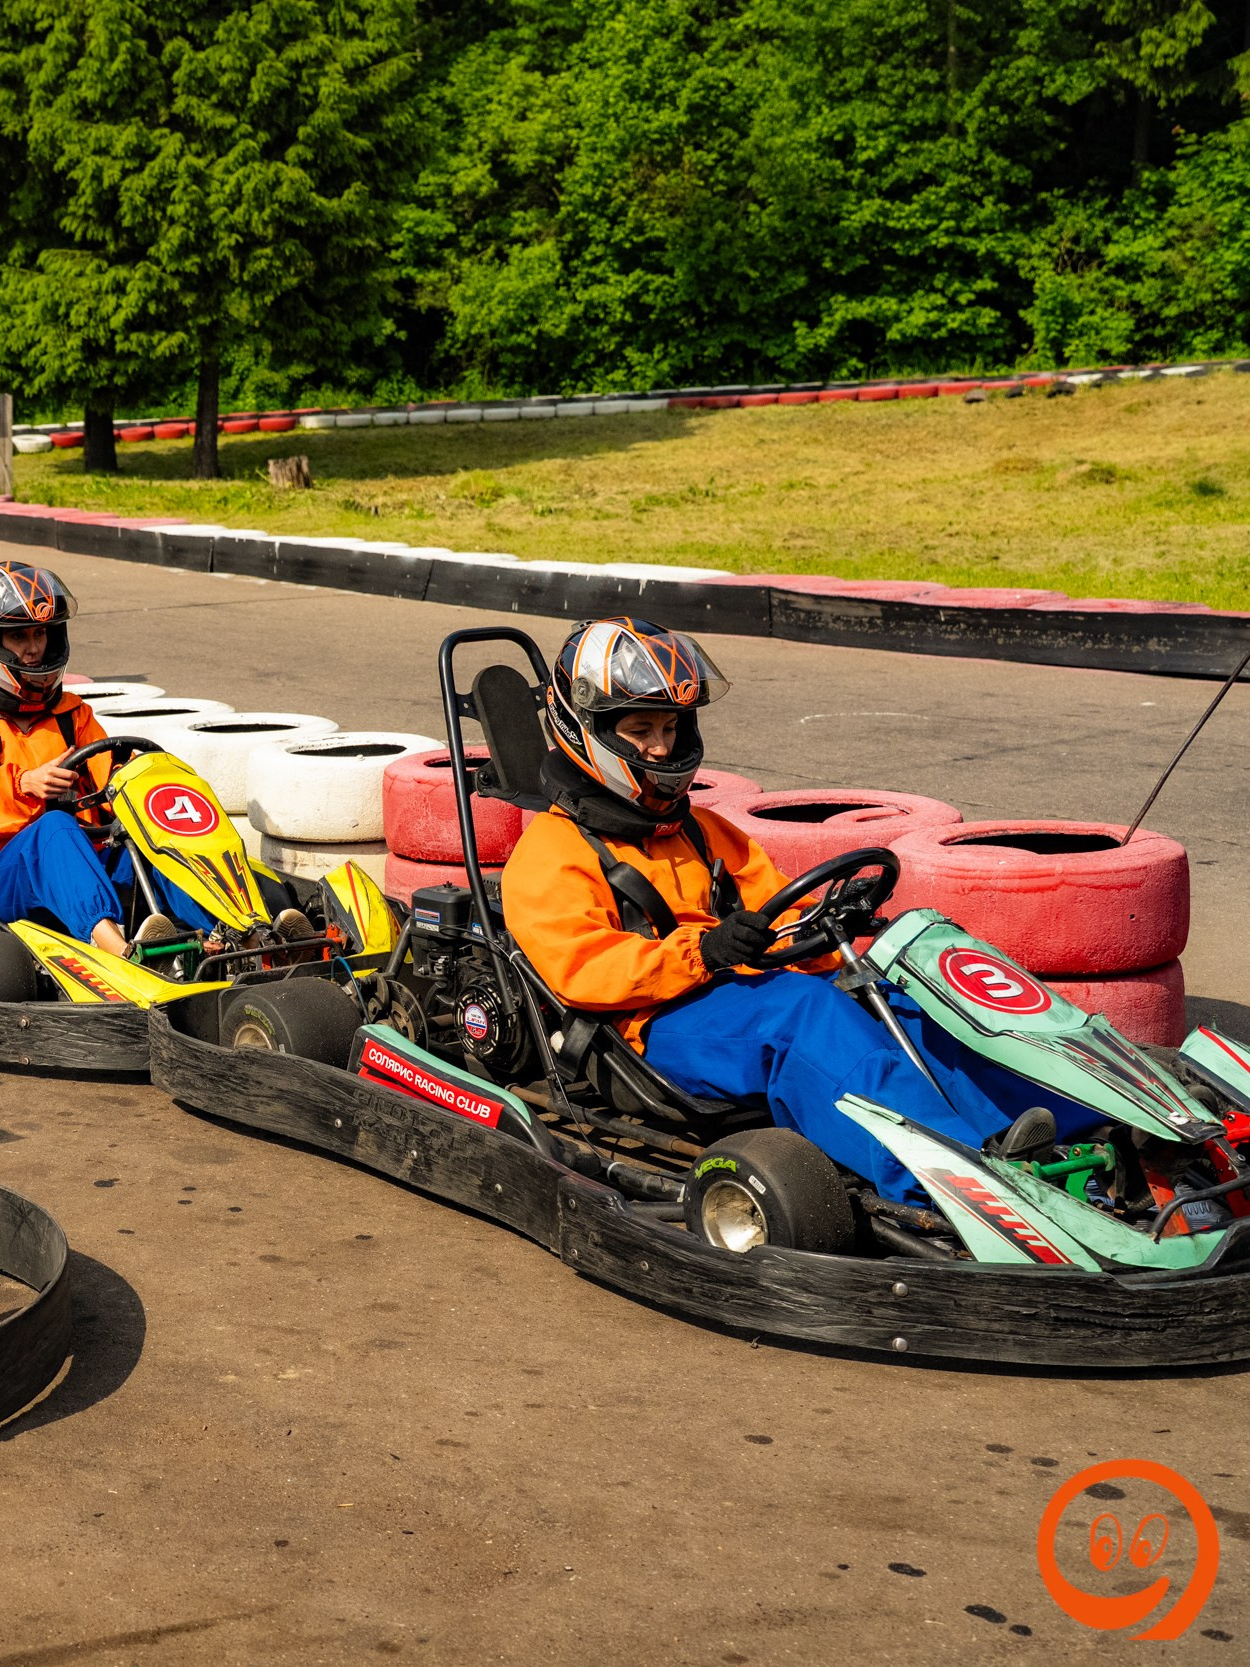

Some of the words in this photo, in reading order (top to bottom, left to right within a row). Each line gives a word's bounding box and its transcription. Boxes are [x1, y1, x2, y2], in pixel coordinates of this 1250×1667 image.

[163, 795, 202, 823] 4
[960, 963, 1024, 999] 3
[368, 1048, 414, 1082] СОЛЯРИС
[414, 1074, 455, 1104] RACING
[456, 1096, 491, 1119] CLUB
[695, 1157, 737, 1180] VEGA
